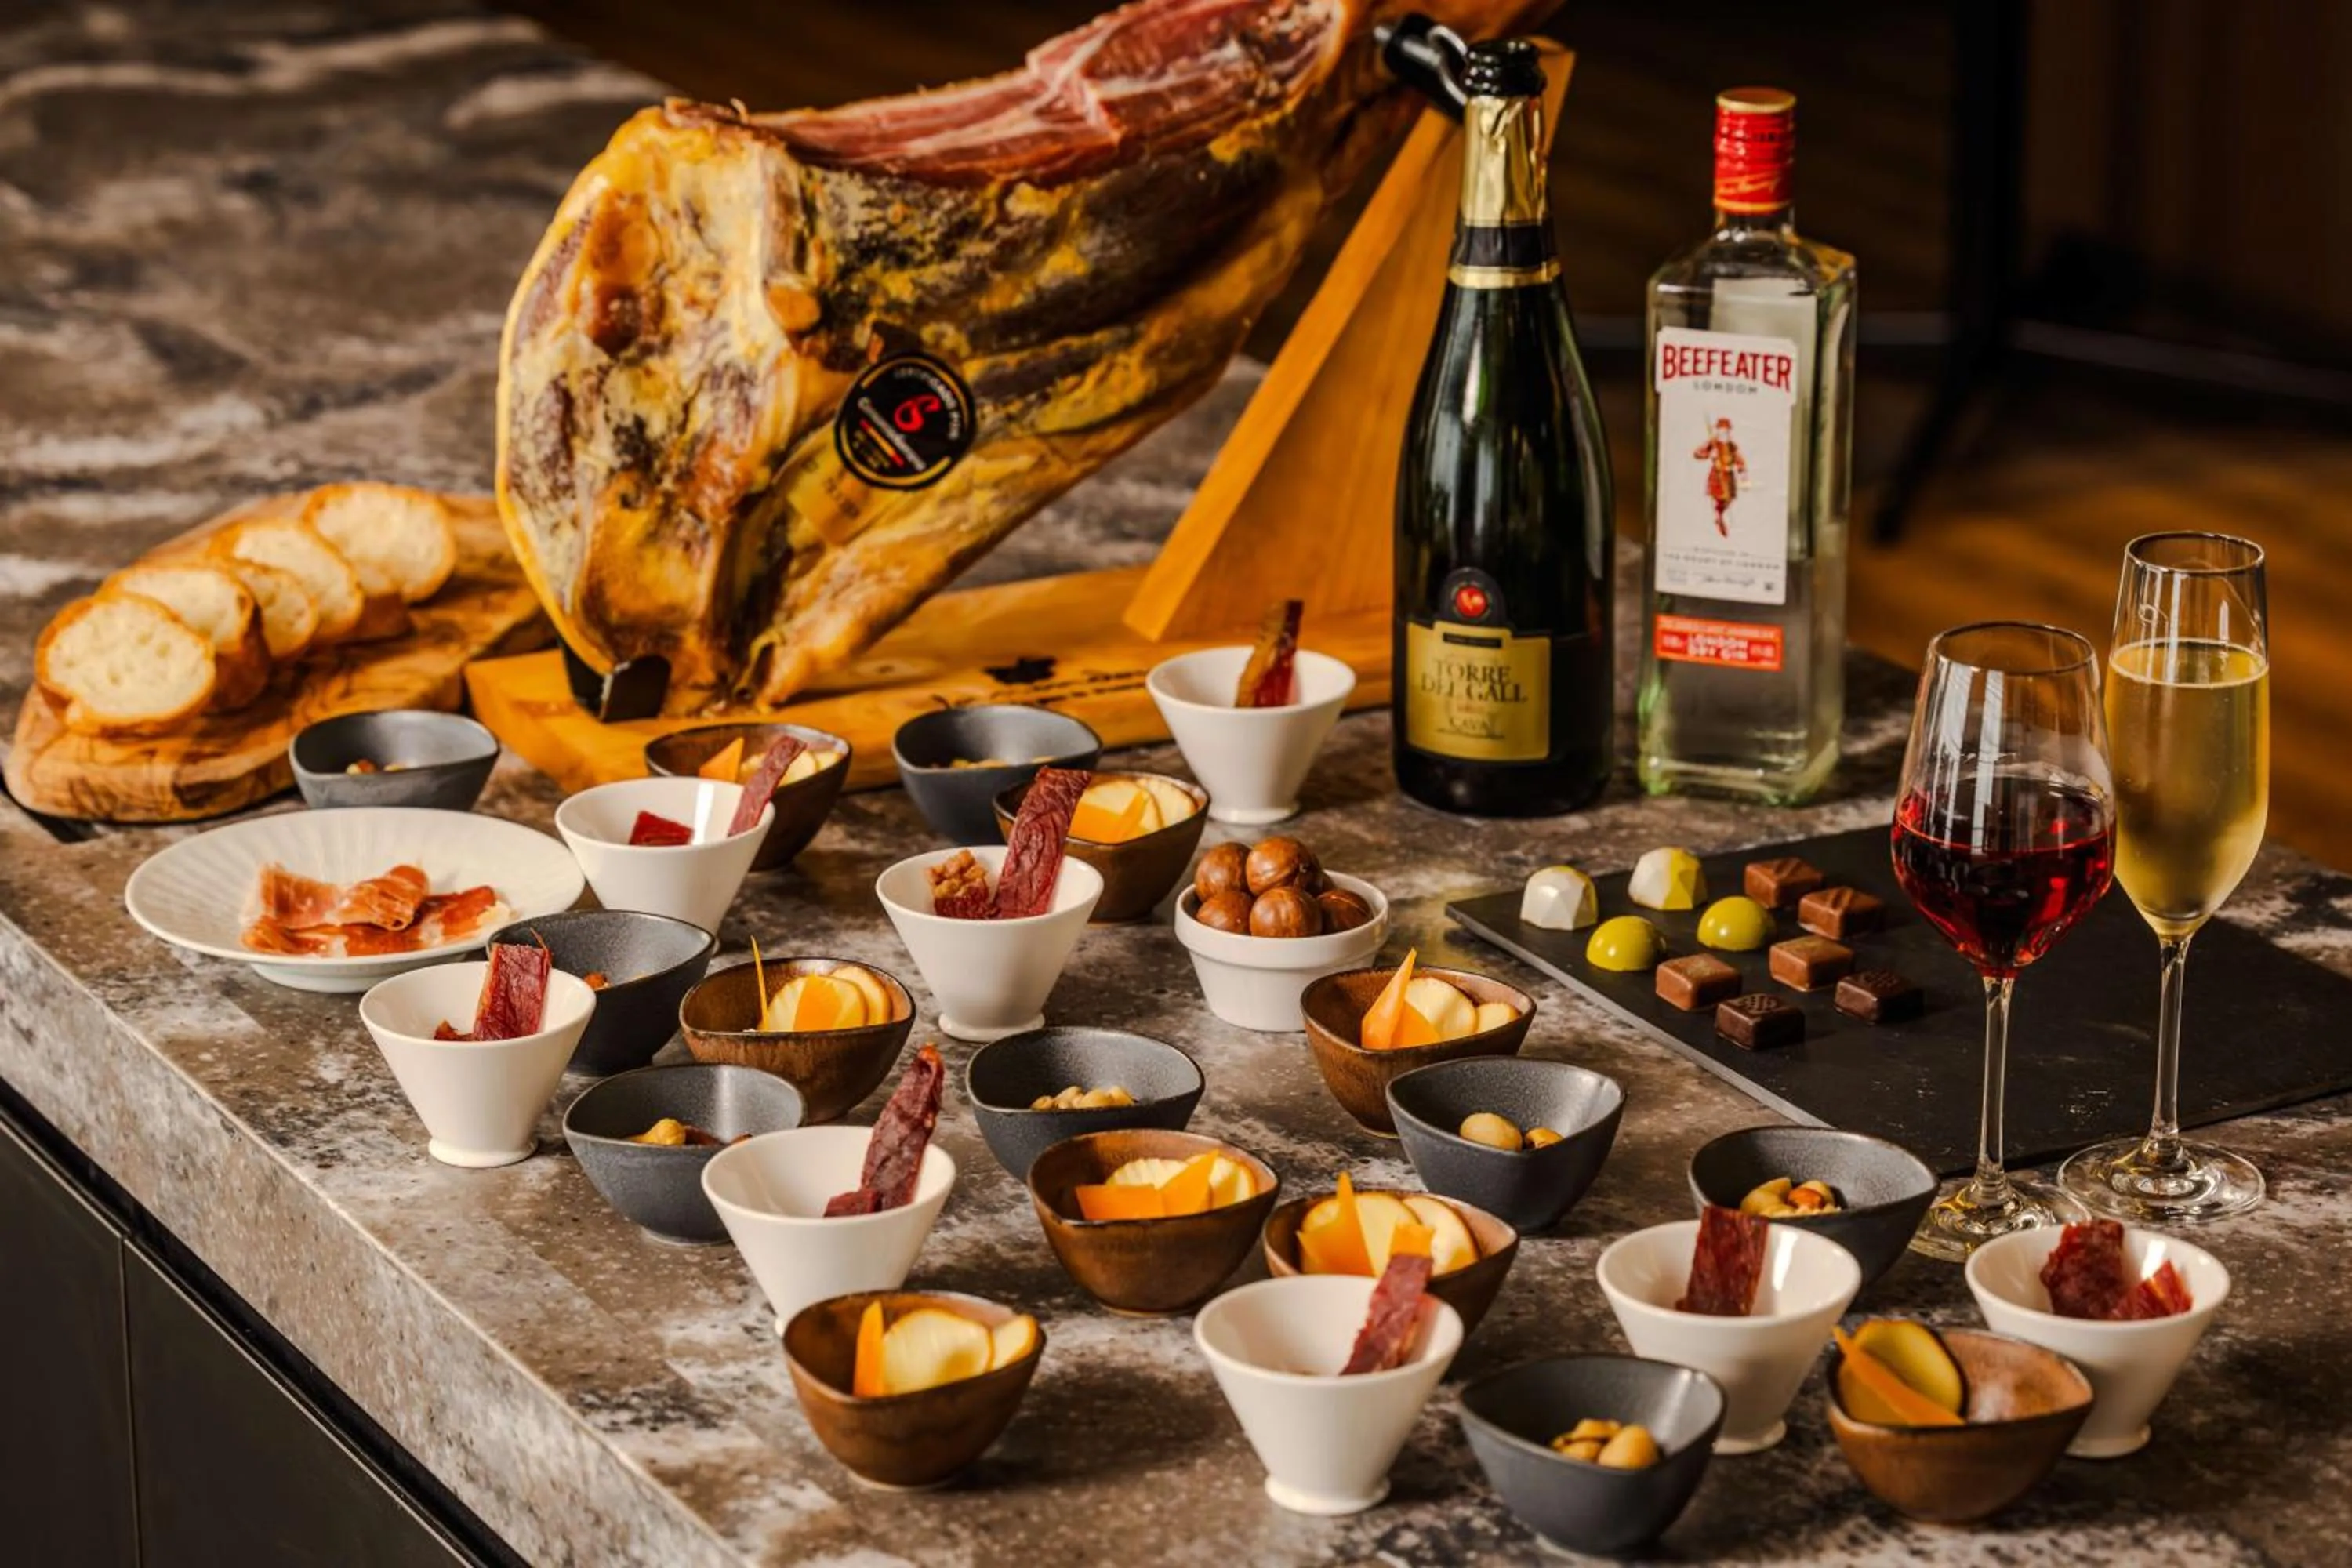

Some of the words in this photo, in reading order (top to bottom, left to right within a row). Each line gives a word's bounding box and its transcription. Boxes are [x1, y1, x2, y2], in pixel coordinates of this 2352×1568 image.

[1662, 343, 1791, 393] BEEFEATER
[1693, 380, 1758, 394] LONDON
[1433, 660, 1512, 684] TORRE
